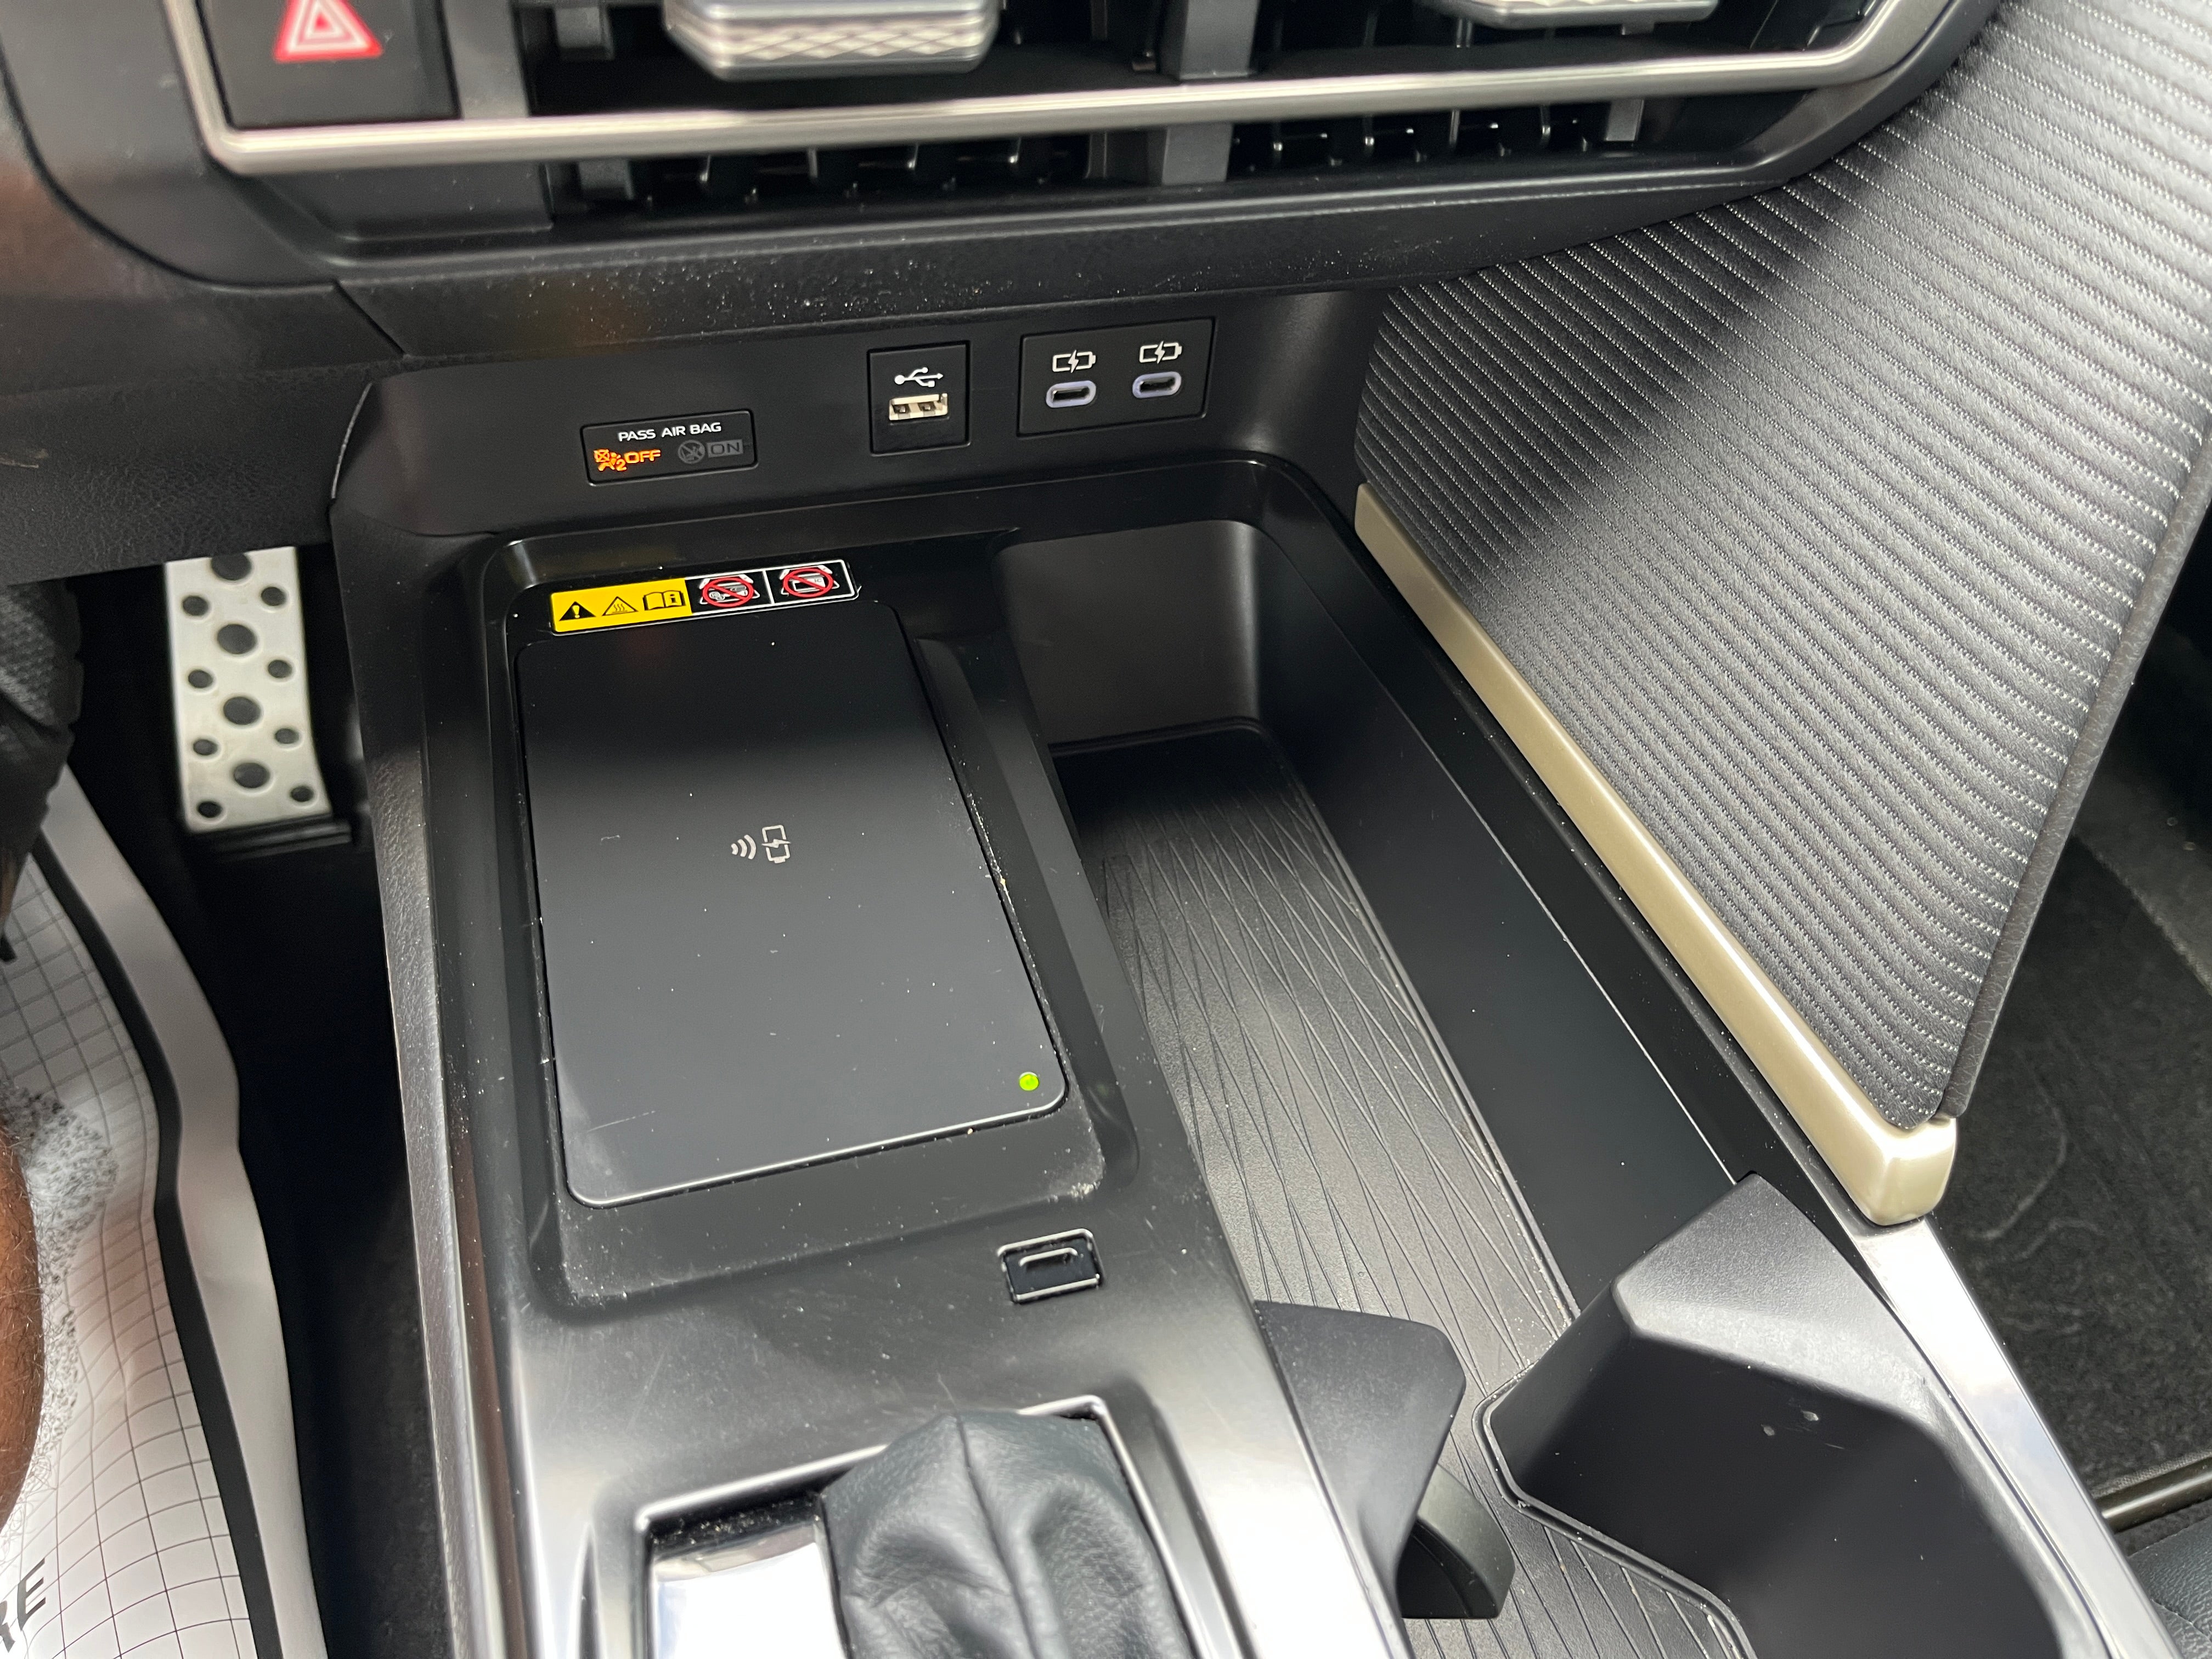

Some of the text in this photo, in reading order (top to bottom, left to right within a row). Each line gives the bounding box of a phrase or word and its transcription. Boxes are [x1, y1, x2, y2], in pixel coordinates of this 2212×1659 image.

[618, 422, 721, 442] PASS AIR BAG
[710, 442, 740, 455] ON
[624, 449, 661, 464] OFF
